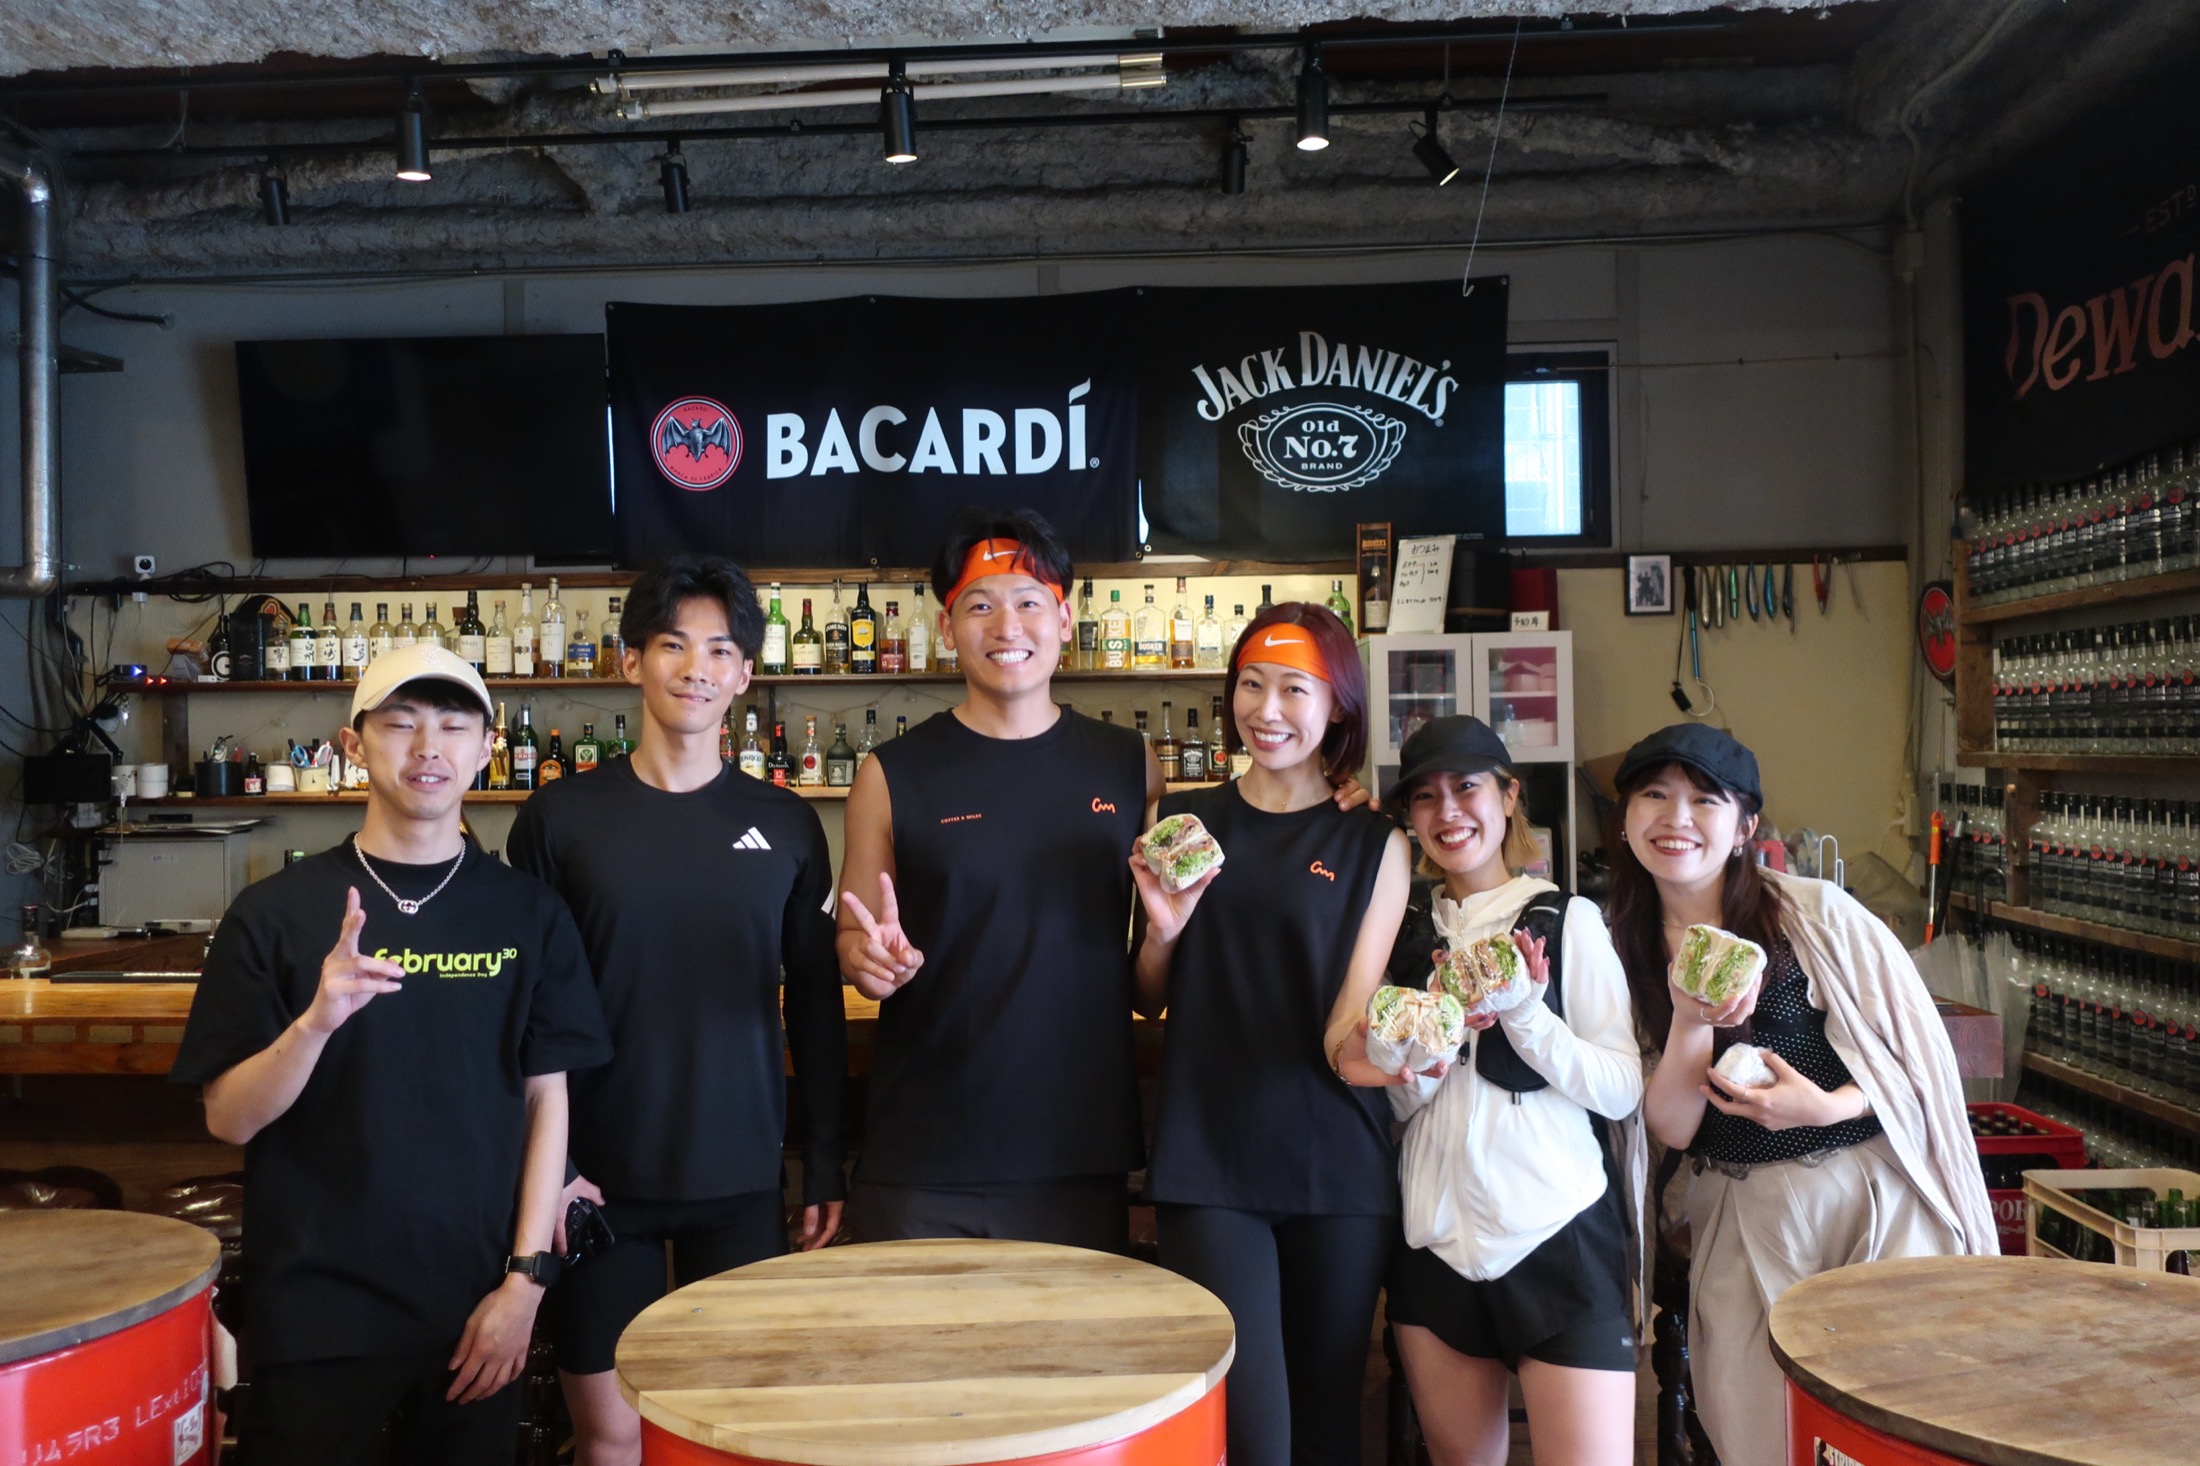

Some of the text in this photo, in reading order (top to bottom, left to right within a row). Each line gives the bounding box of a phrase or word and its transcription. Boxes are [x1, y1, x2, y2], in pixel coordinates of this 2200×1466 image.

[2005, 251, 2200, 402] Dewa
[1192, 331, 1459, 422] JACK DANIEL'S
[767, 377, 1092, 479] BACARDÍ
[1301, 420, 1340, 433] Old
[1301, 462, 1343, 470] BRAND
[776, 770, 783, 779] 12
